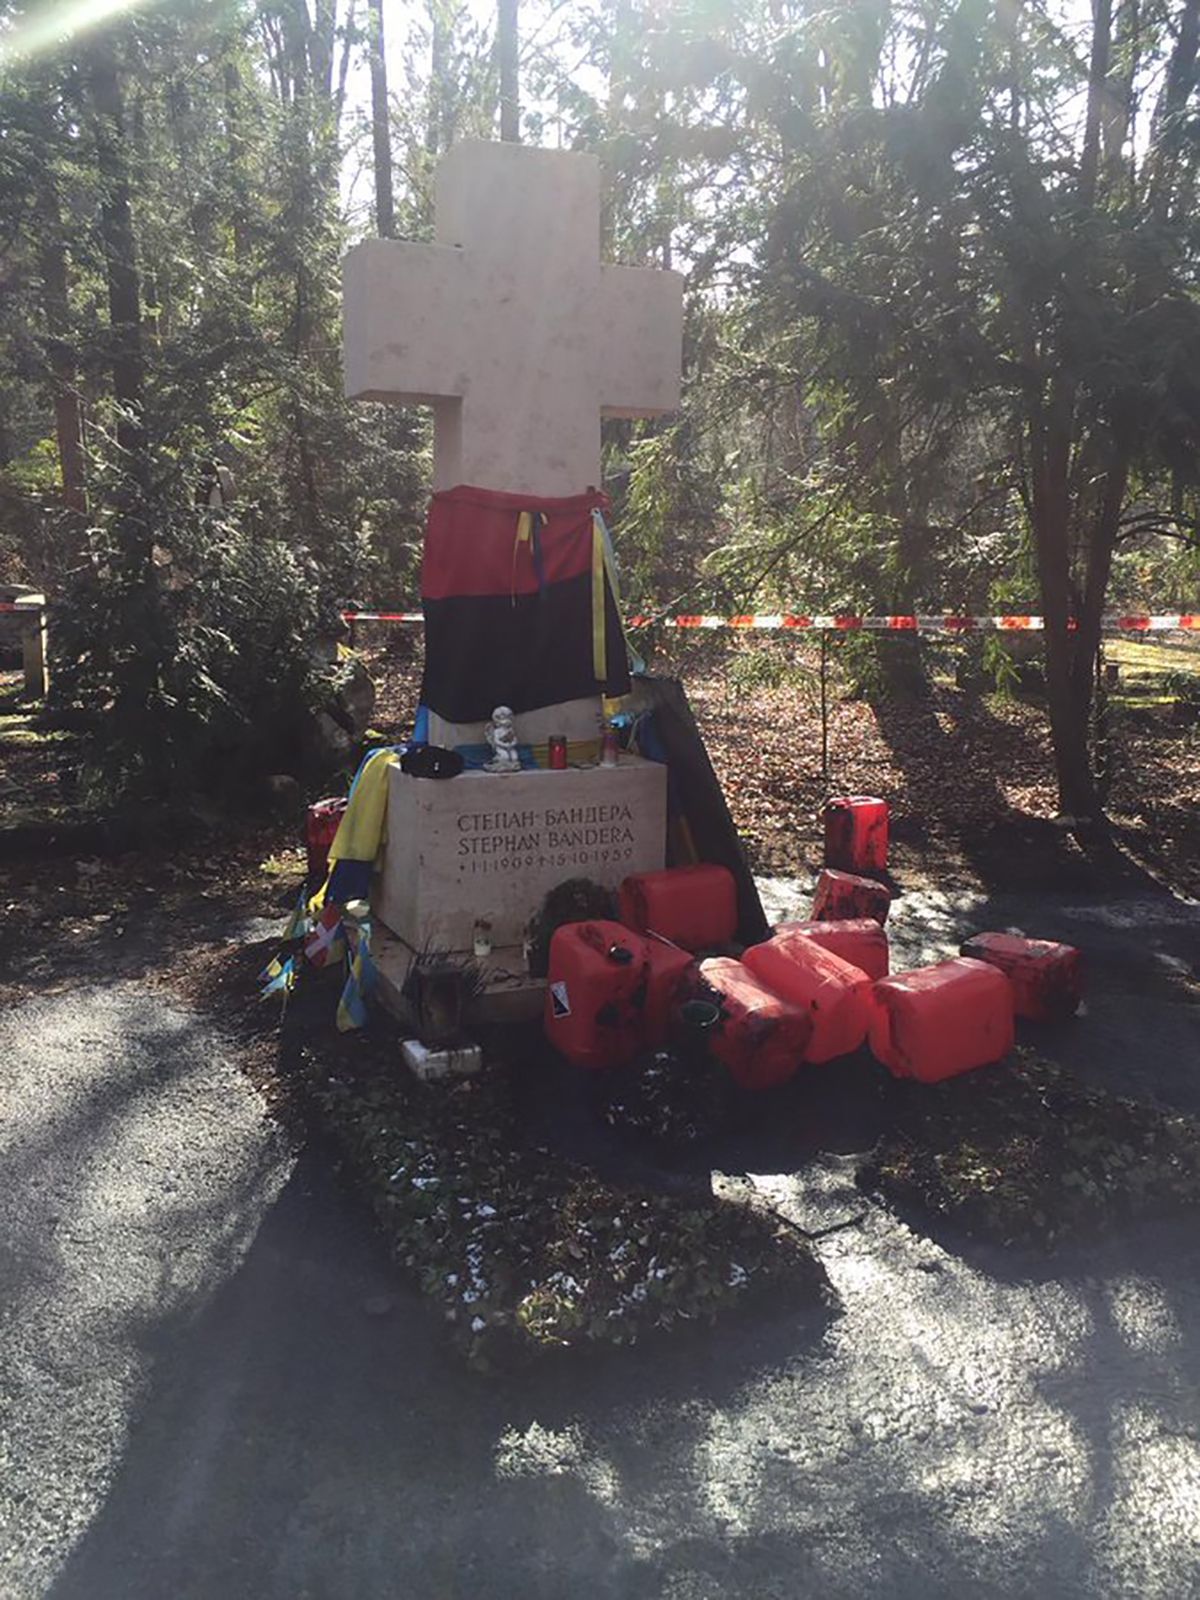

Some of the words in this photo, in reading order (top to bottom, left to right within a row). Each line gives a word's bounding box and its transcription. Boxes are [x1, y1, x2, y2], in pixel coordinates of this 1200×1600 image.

[457, 811, 535, 832] СТЕПАН
[545, 805, 632, 827] БАНДЕРА
[458, 832, 540, 856] STEPHAN
[549, 826, 635, 849] BANDERA
